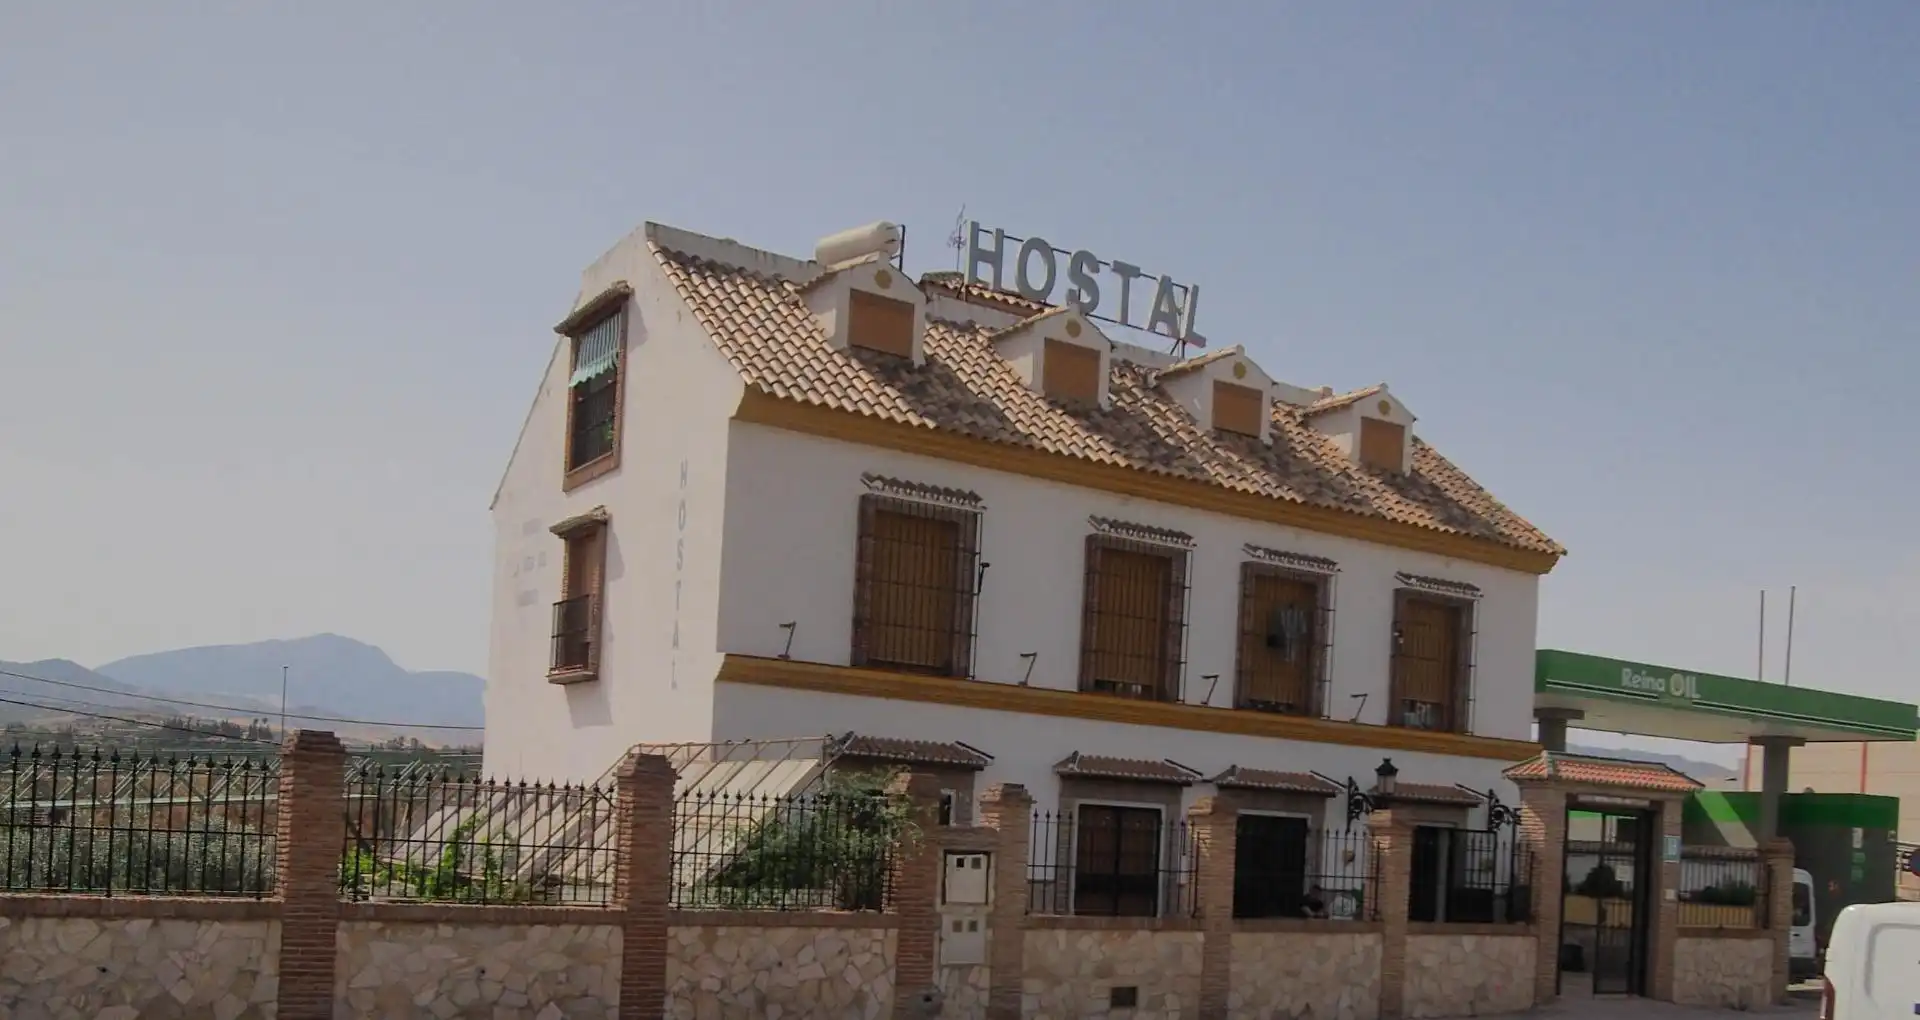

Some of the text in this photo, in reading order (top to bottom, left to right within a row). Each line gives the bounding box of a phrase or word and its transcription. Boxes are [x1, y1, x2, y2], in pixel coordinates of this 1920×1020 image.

[964, 220, 1206, 348] HOSTAL
[671, 457, 688, 690] HOSTAL
[1621, 667, 1701, 698] Reina OIL
